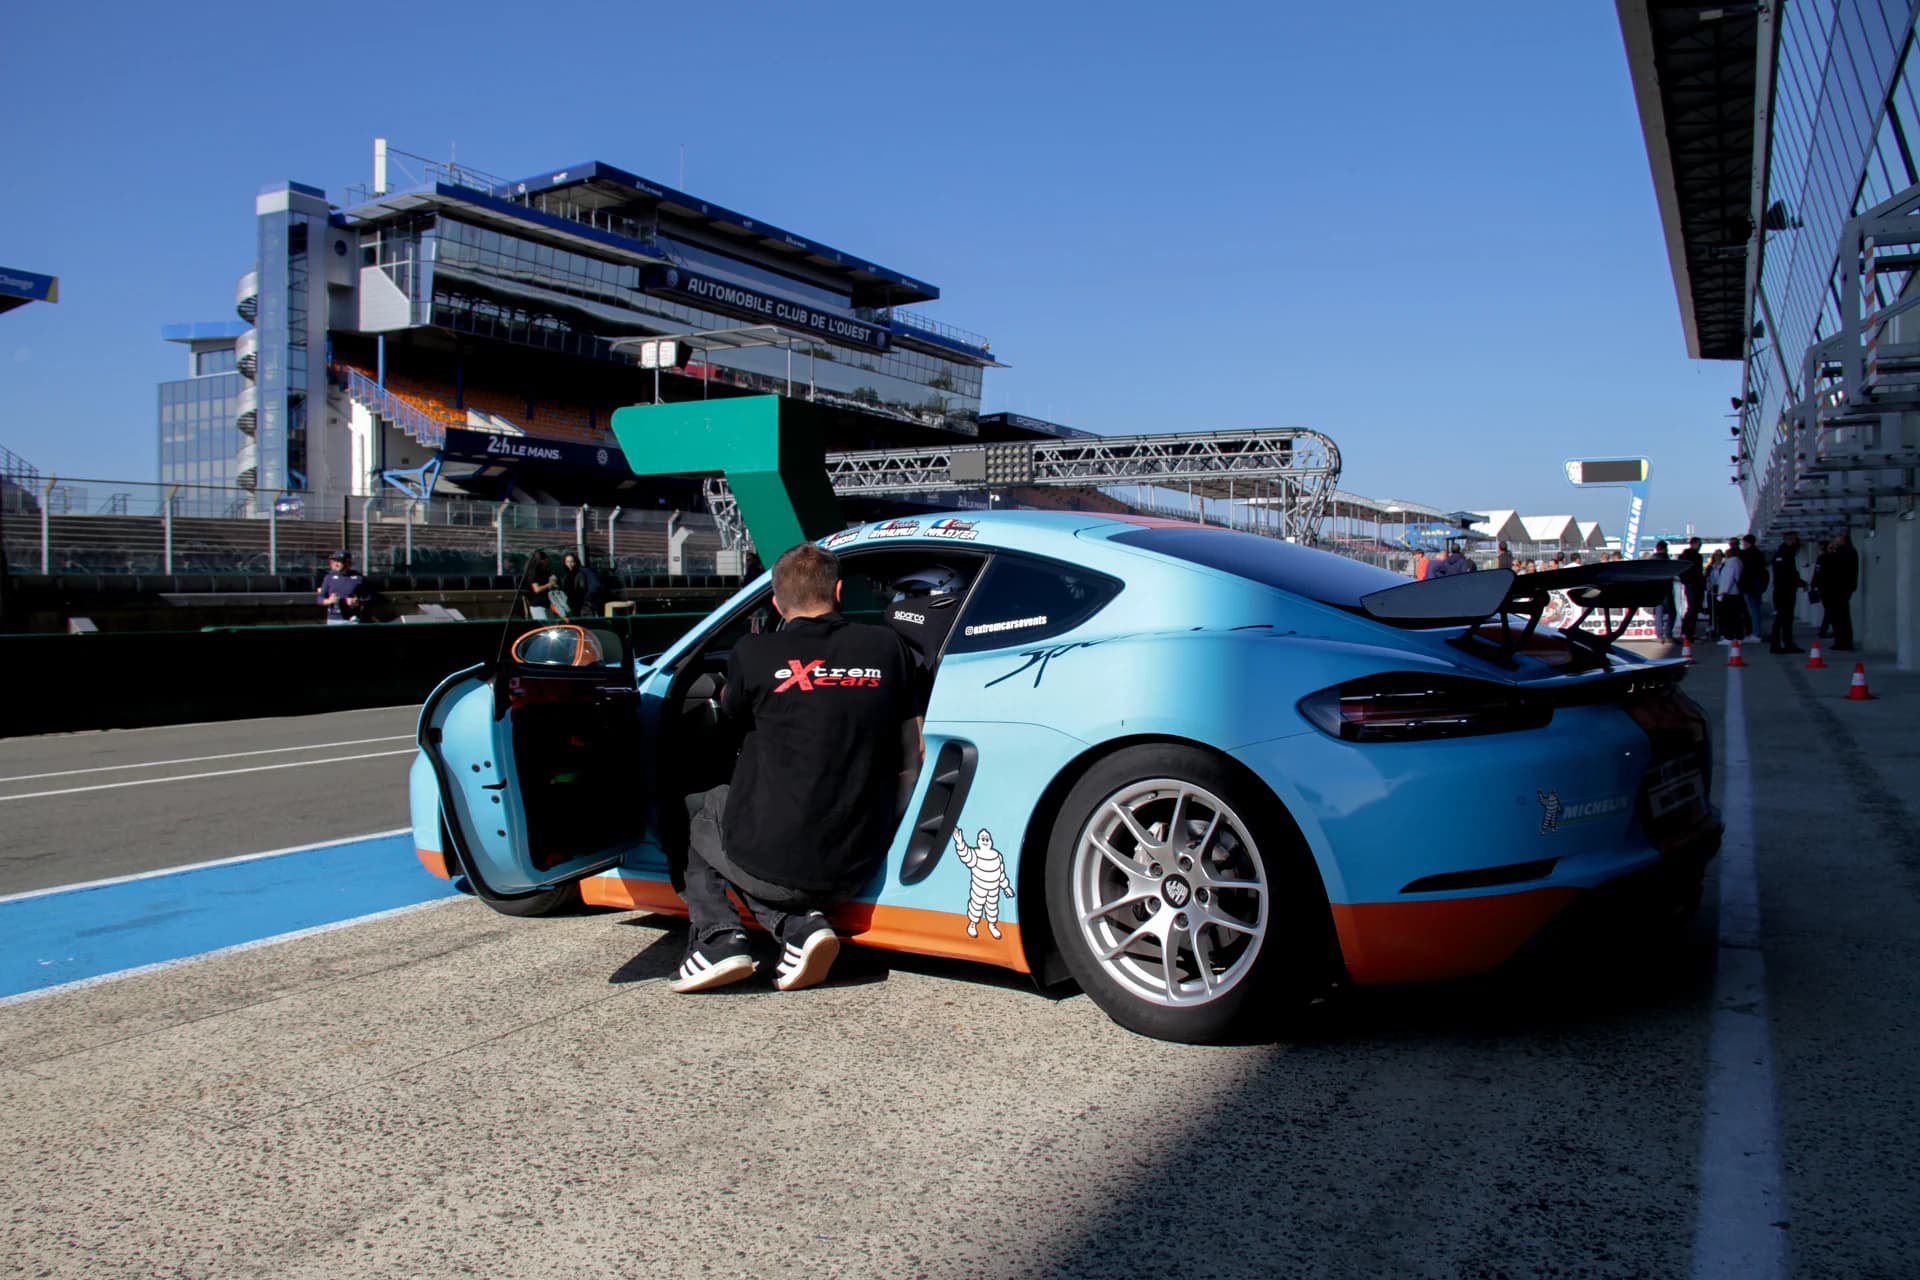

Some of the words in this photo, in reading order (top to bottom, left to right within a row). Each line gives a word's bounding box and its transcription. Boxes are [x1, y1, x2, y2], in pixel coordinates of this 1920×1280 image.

[687, 277, 773, 314] AUTOMOBILE
[776, 303, 807, 323] CLUB
[810, 313, 826, 329] DE
[829, 318, 872, 341] L'OUEST
[487, 435, 510, 454] 24h
[512, 444, 526, 456] LE
[527, 447, 560, 460] MANS
[893, 610, 925, 624] sparco
[1562, 797, 1628, 819] MICHELIN
